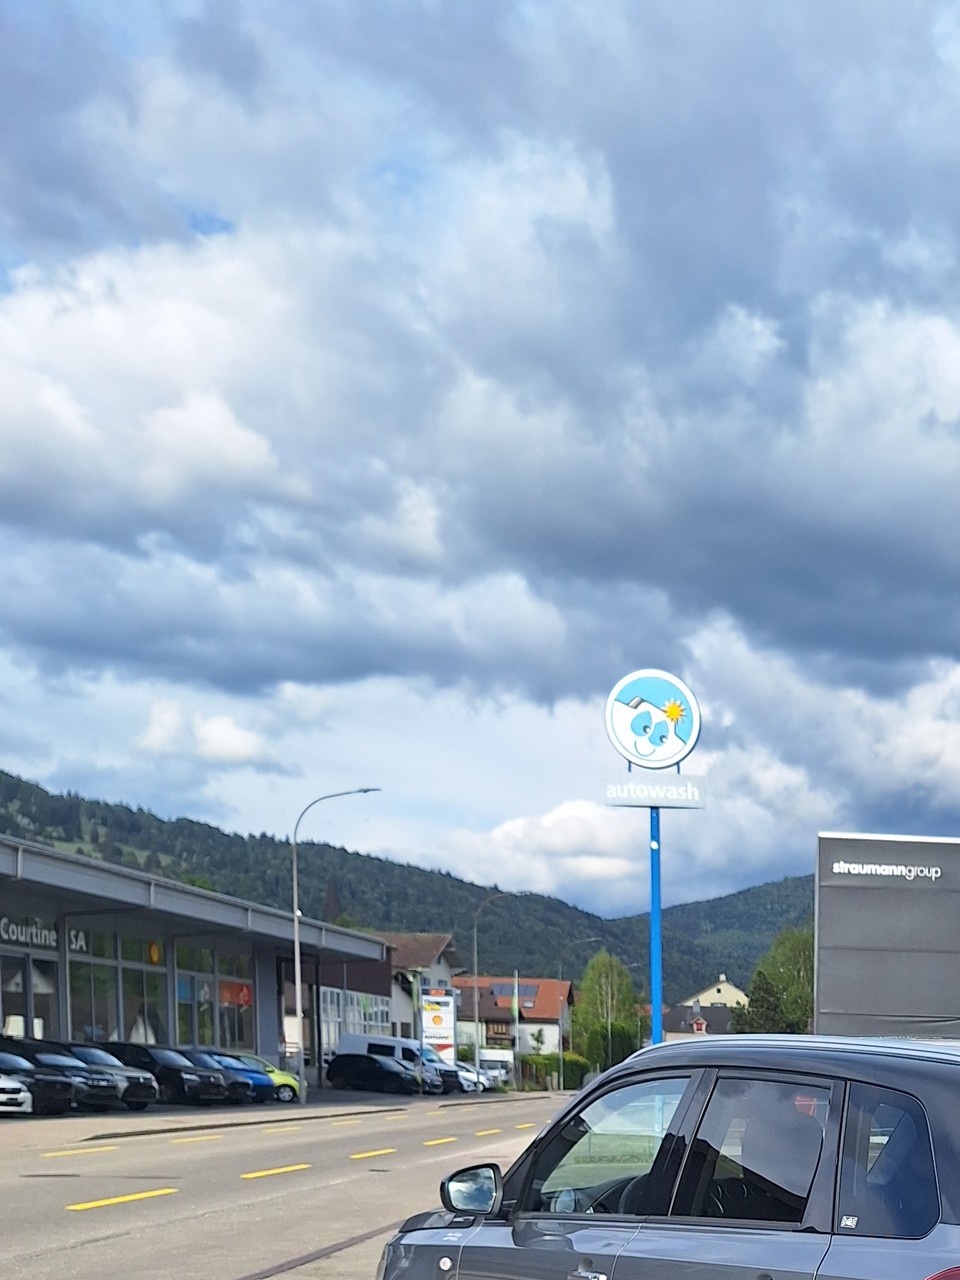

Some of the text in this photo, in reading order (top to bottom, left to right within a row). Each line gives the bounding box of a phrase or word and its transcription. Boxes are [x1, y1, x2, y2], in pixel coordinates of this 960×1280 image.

[606, 782, 699, 800] autowash
[832, 860, 942, 882] straumanngroup
[0, 916, 87, 952] Courtine SA
